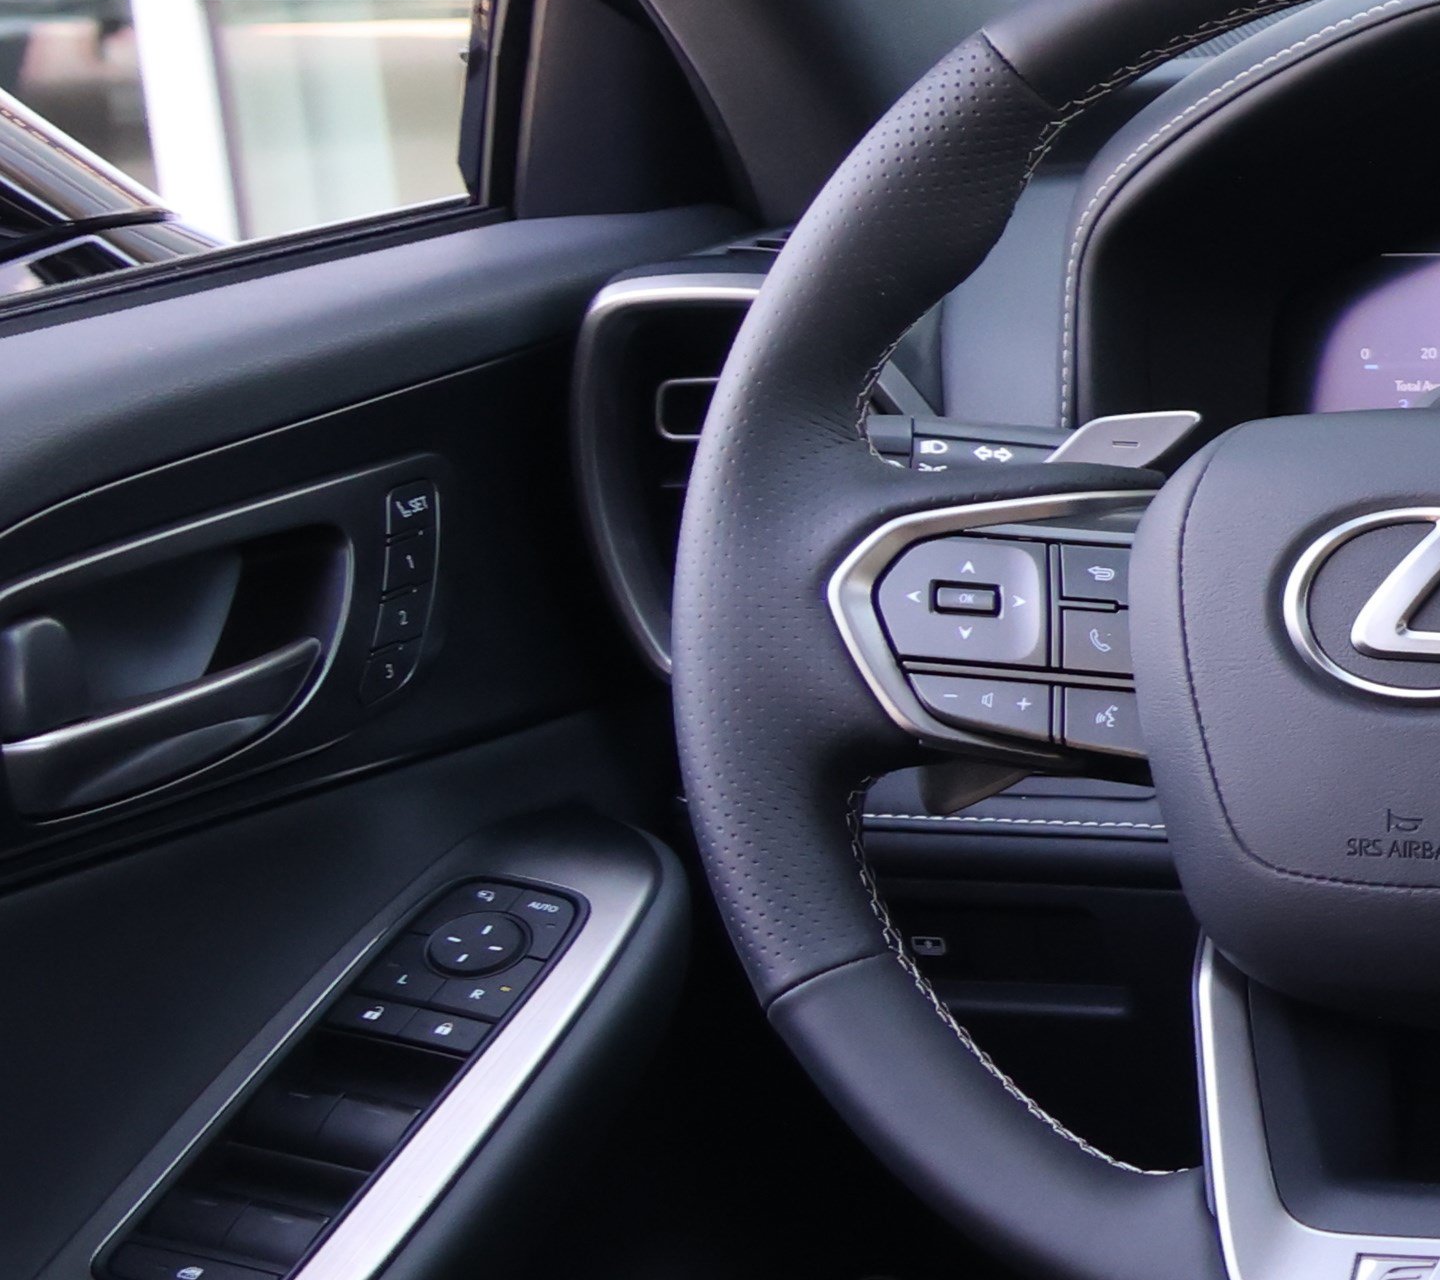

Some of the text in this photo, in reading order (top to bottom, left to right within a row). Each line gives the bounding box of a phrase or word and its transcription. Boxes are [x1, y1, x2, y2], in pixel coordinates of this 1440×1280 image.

[1360, 347, 1371, 360] 0
[1420, 347, 1437, 360] 20
[1395, 380, 1420, 392] Total
[408, 496, 428, 513] SET
[959, 592, 975, 604] OK
[399, 610, 409, 626] 2
[385, 663, 395, 679] 3
[1346, 838, 1382, 857] SRS
[528, 901, 559, 913] AUTO
[396, 974, 408, 985] L
[469, 988, 486, 1000] R
